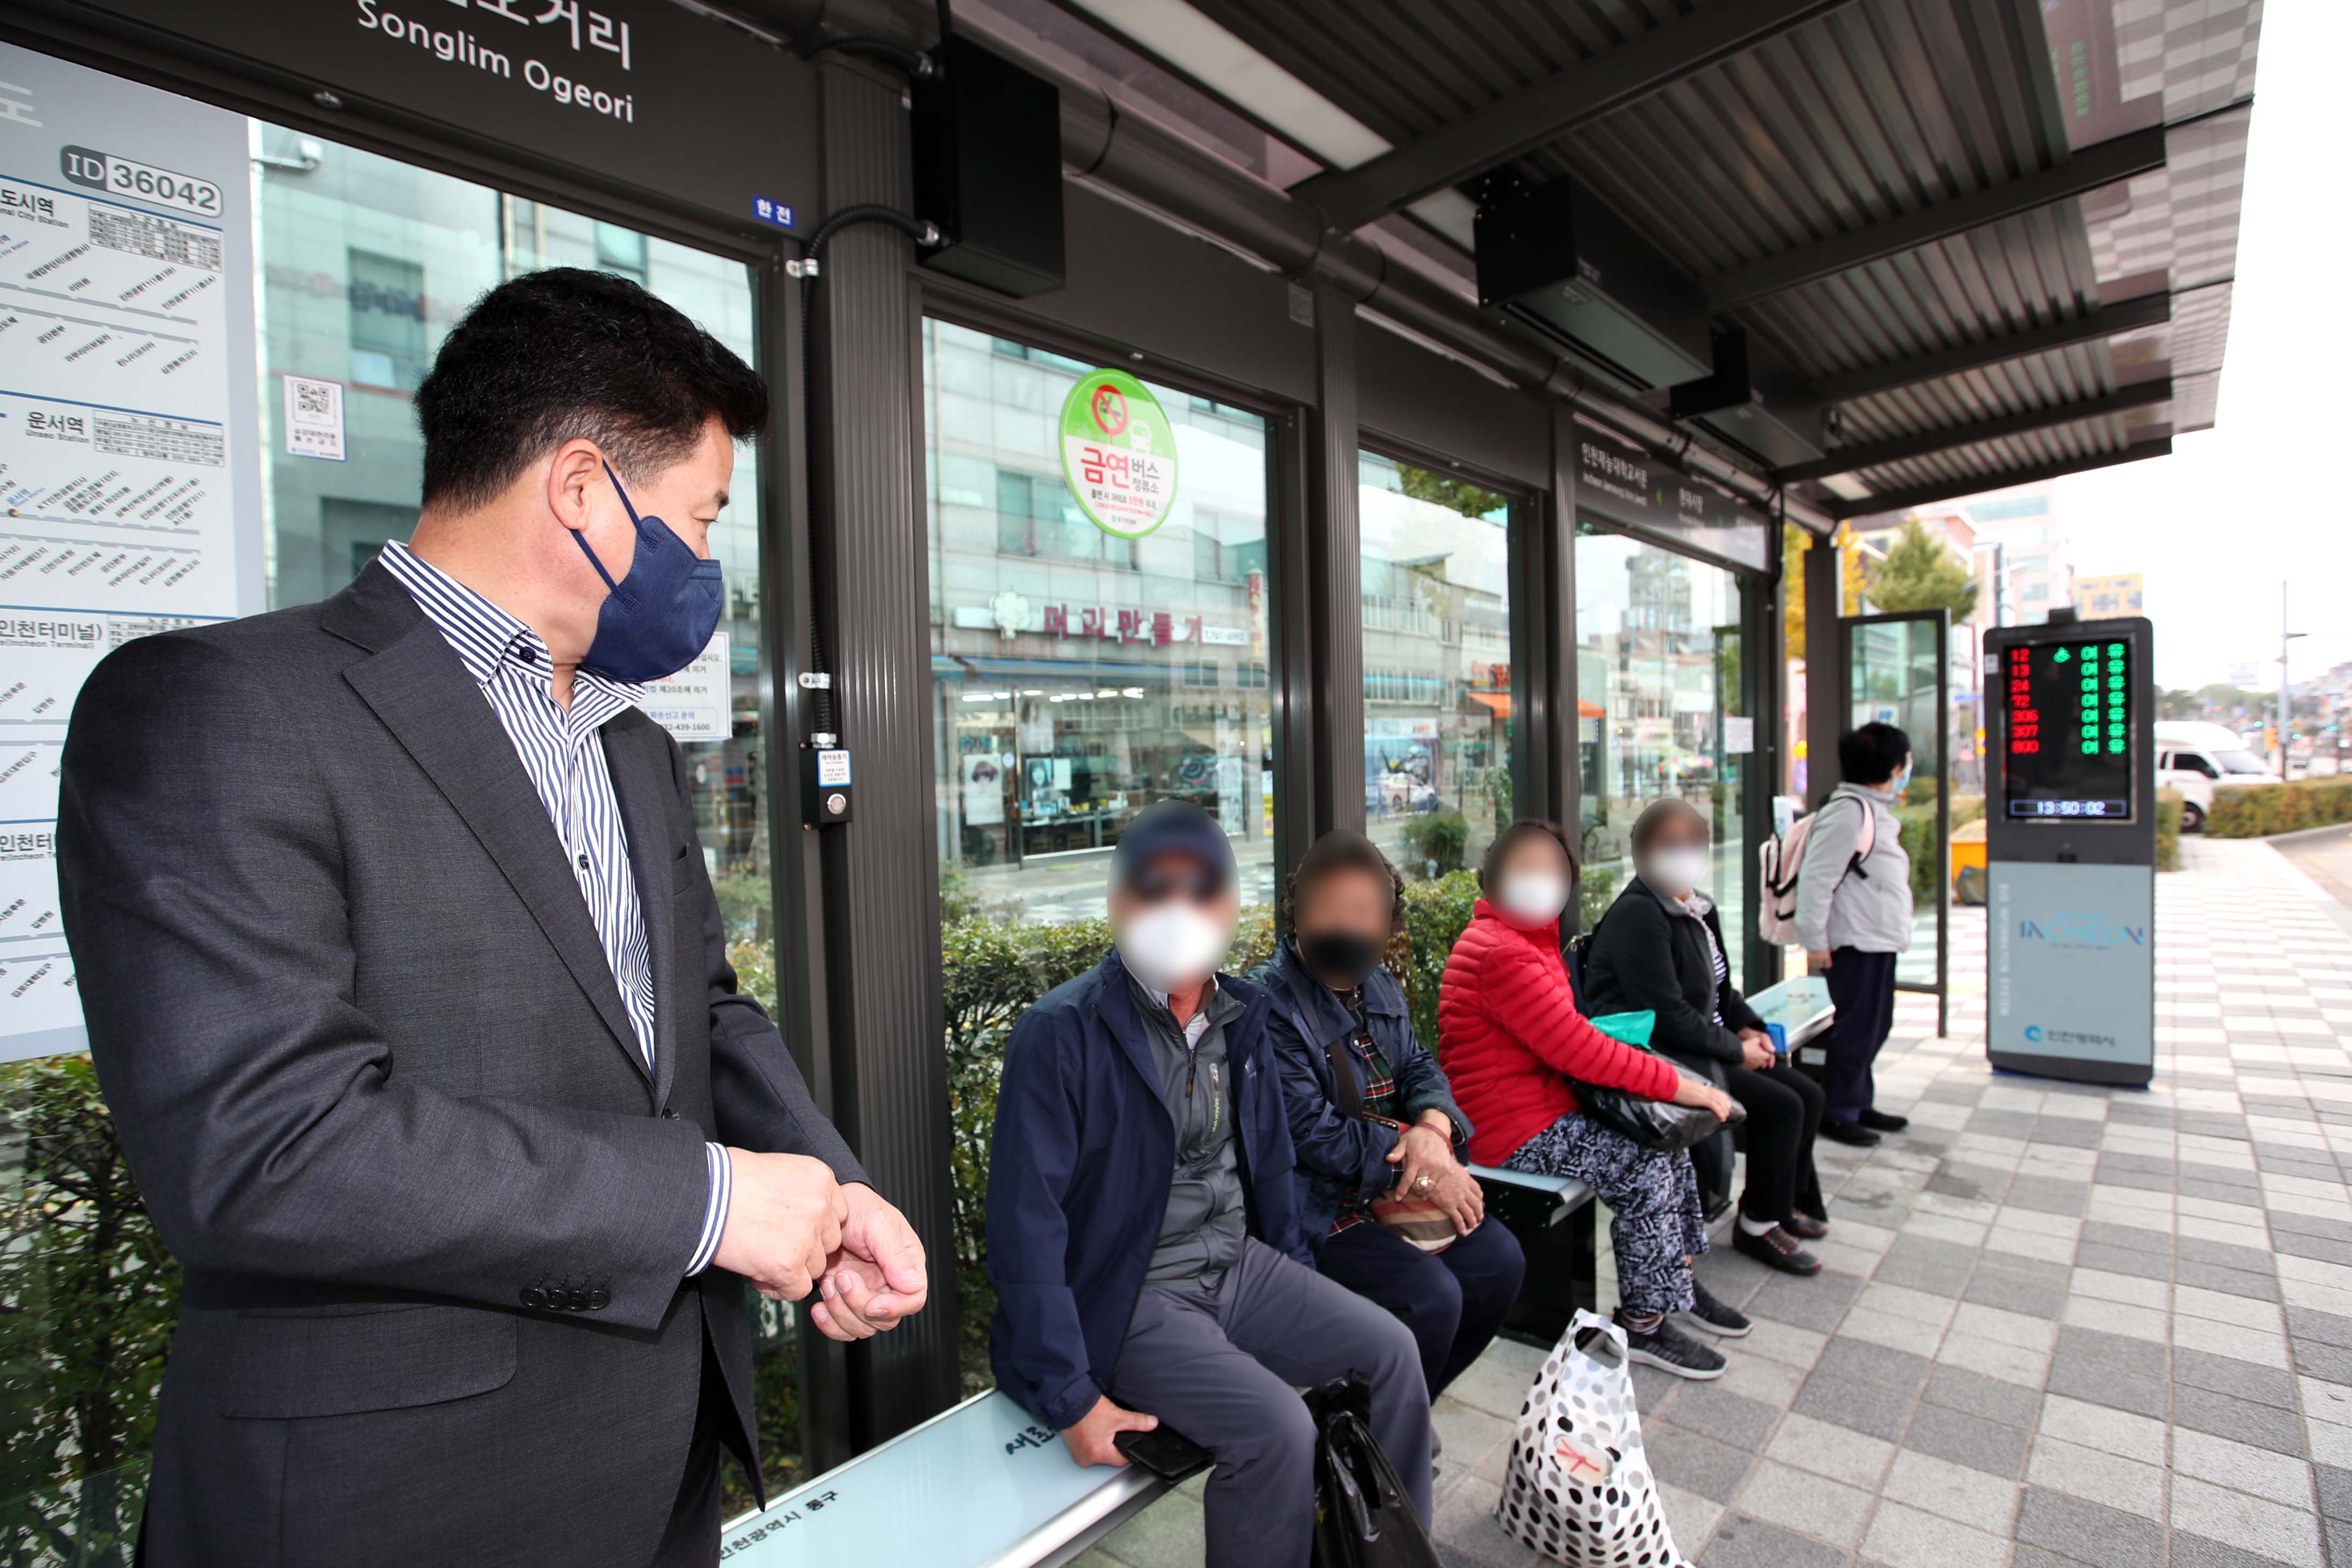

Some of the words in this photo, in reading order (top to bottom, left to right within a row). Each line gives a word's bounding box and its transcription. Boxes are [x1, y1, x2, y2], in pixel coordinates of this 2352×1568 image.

[356, 0, 511, 79] Songlim
[523, 59, 634, 123] Ogeori
[67, 153, 106, 182] ID
[113, 163, 218, 212] 36042
[27, 411, 85, 436] 운서역
[1080, 446, 1130, 490] 금연
[1131, 457, 1160, 480] 버스
[1132, 478, 1159, 494] 정류소
[1044, 601, 1204, 648] 머리만들기
[2010, 647, 2031, 663] 12
[2010, 693, 2031, 709] 72
[2010, 724, 2040, 739] 307
[2037, 801, 2106, 816] 13:50:02
[0, 832, 57, 852] 인천터
[1004, 1425, 1056, 1455] 새로
[720, 1510, 802, 1561] 인천광역시
[805, 1490, 839, 1511] 동구
